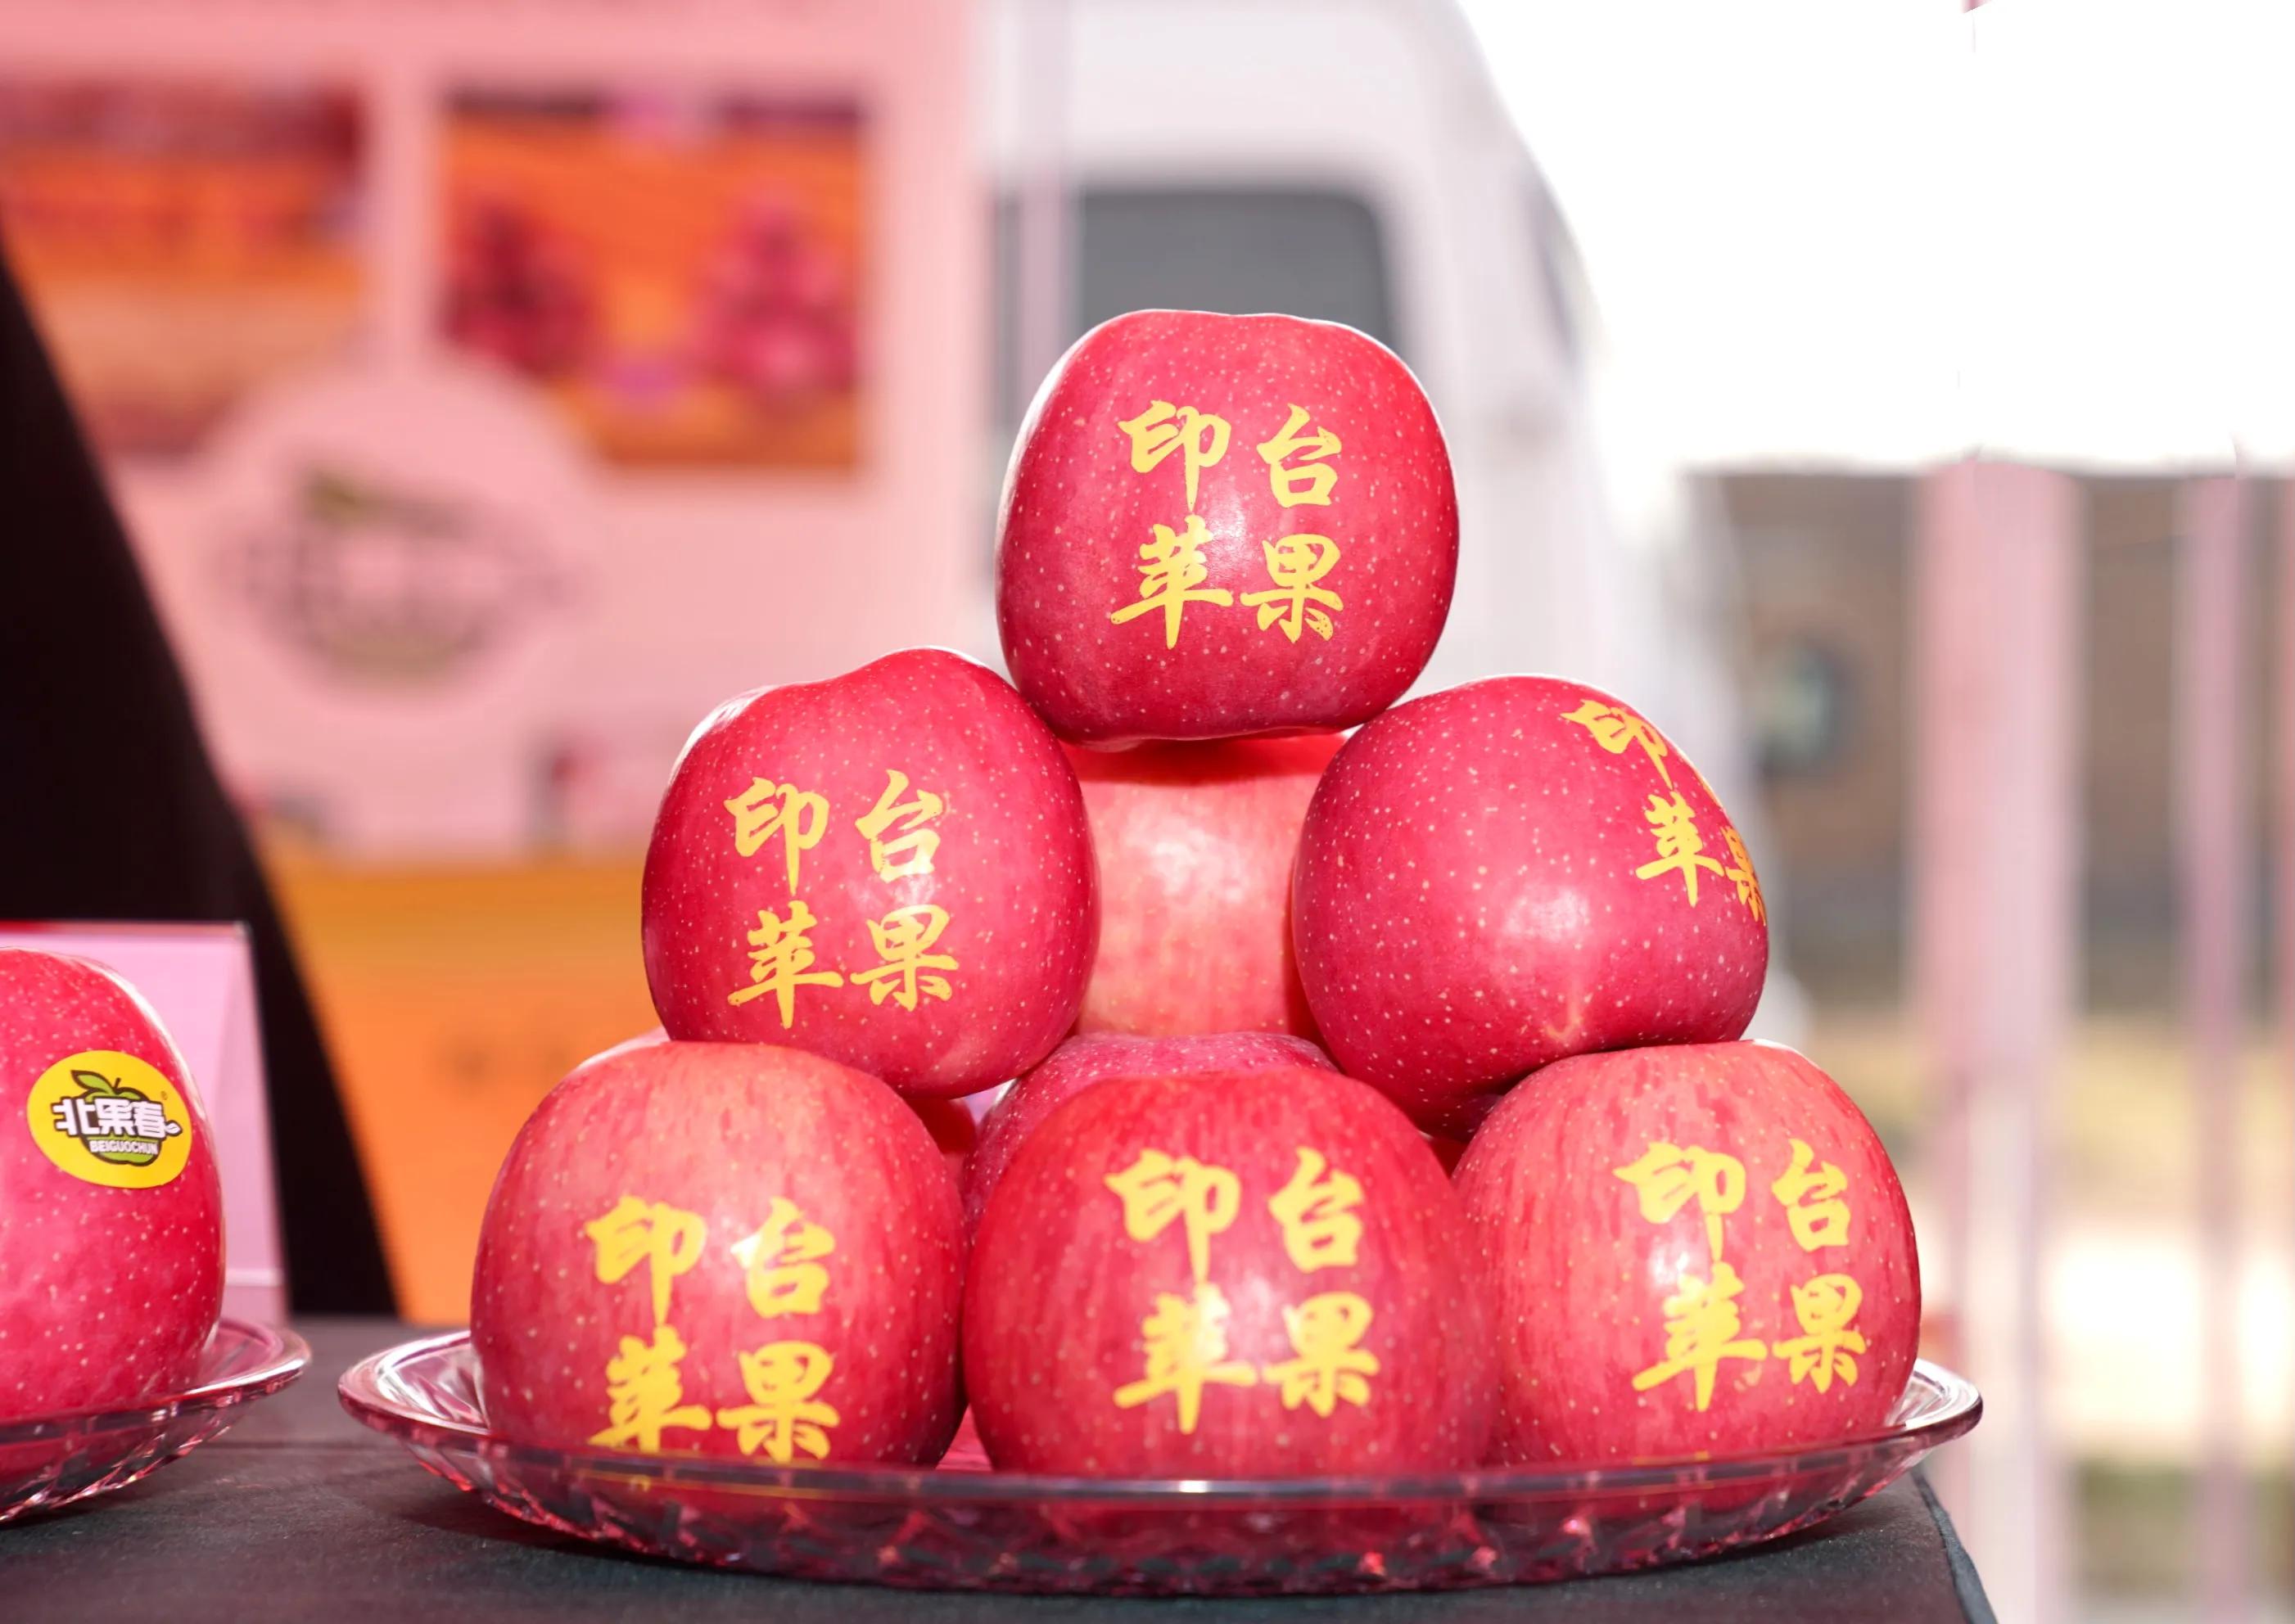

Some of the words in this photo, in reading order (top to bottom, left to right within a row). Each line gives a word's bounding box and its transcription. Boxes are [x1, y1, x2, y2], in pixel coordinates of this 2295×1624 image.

[1118, 400, 1343, 511] 印台
[1109, 513, 1344, 649] 苹果
[1560, 699, 1722, 806] 印
[725, 769, 945, 895] 印台
[728, 899, 960, 1028] 苹果
[51, 1097, 165, 1139] 北果春
[88, 1139, 159, 1155] BEIGUOCHUN
[584, 1195, 836, 1326] 印台
[1105, 1147, 1364, 1283] 印台
[1614, 1138, 1852, 1262] 印台
[586, 1325, 840, 1464] 苹果
[1114, 1280, 1380, 1433] 苹果
[1632, 1261, 1868, 1411] 苹果
